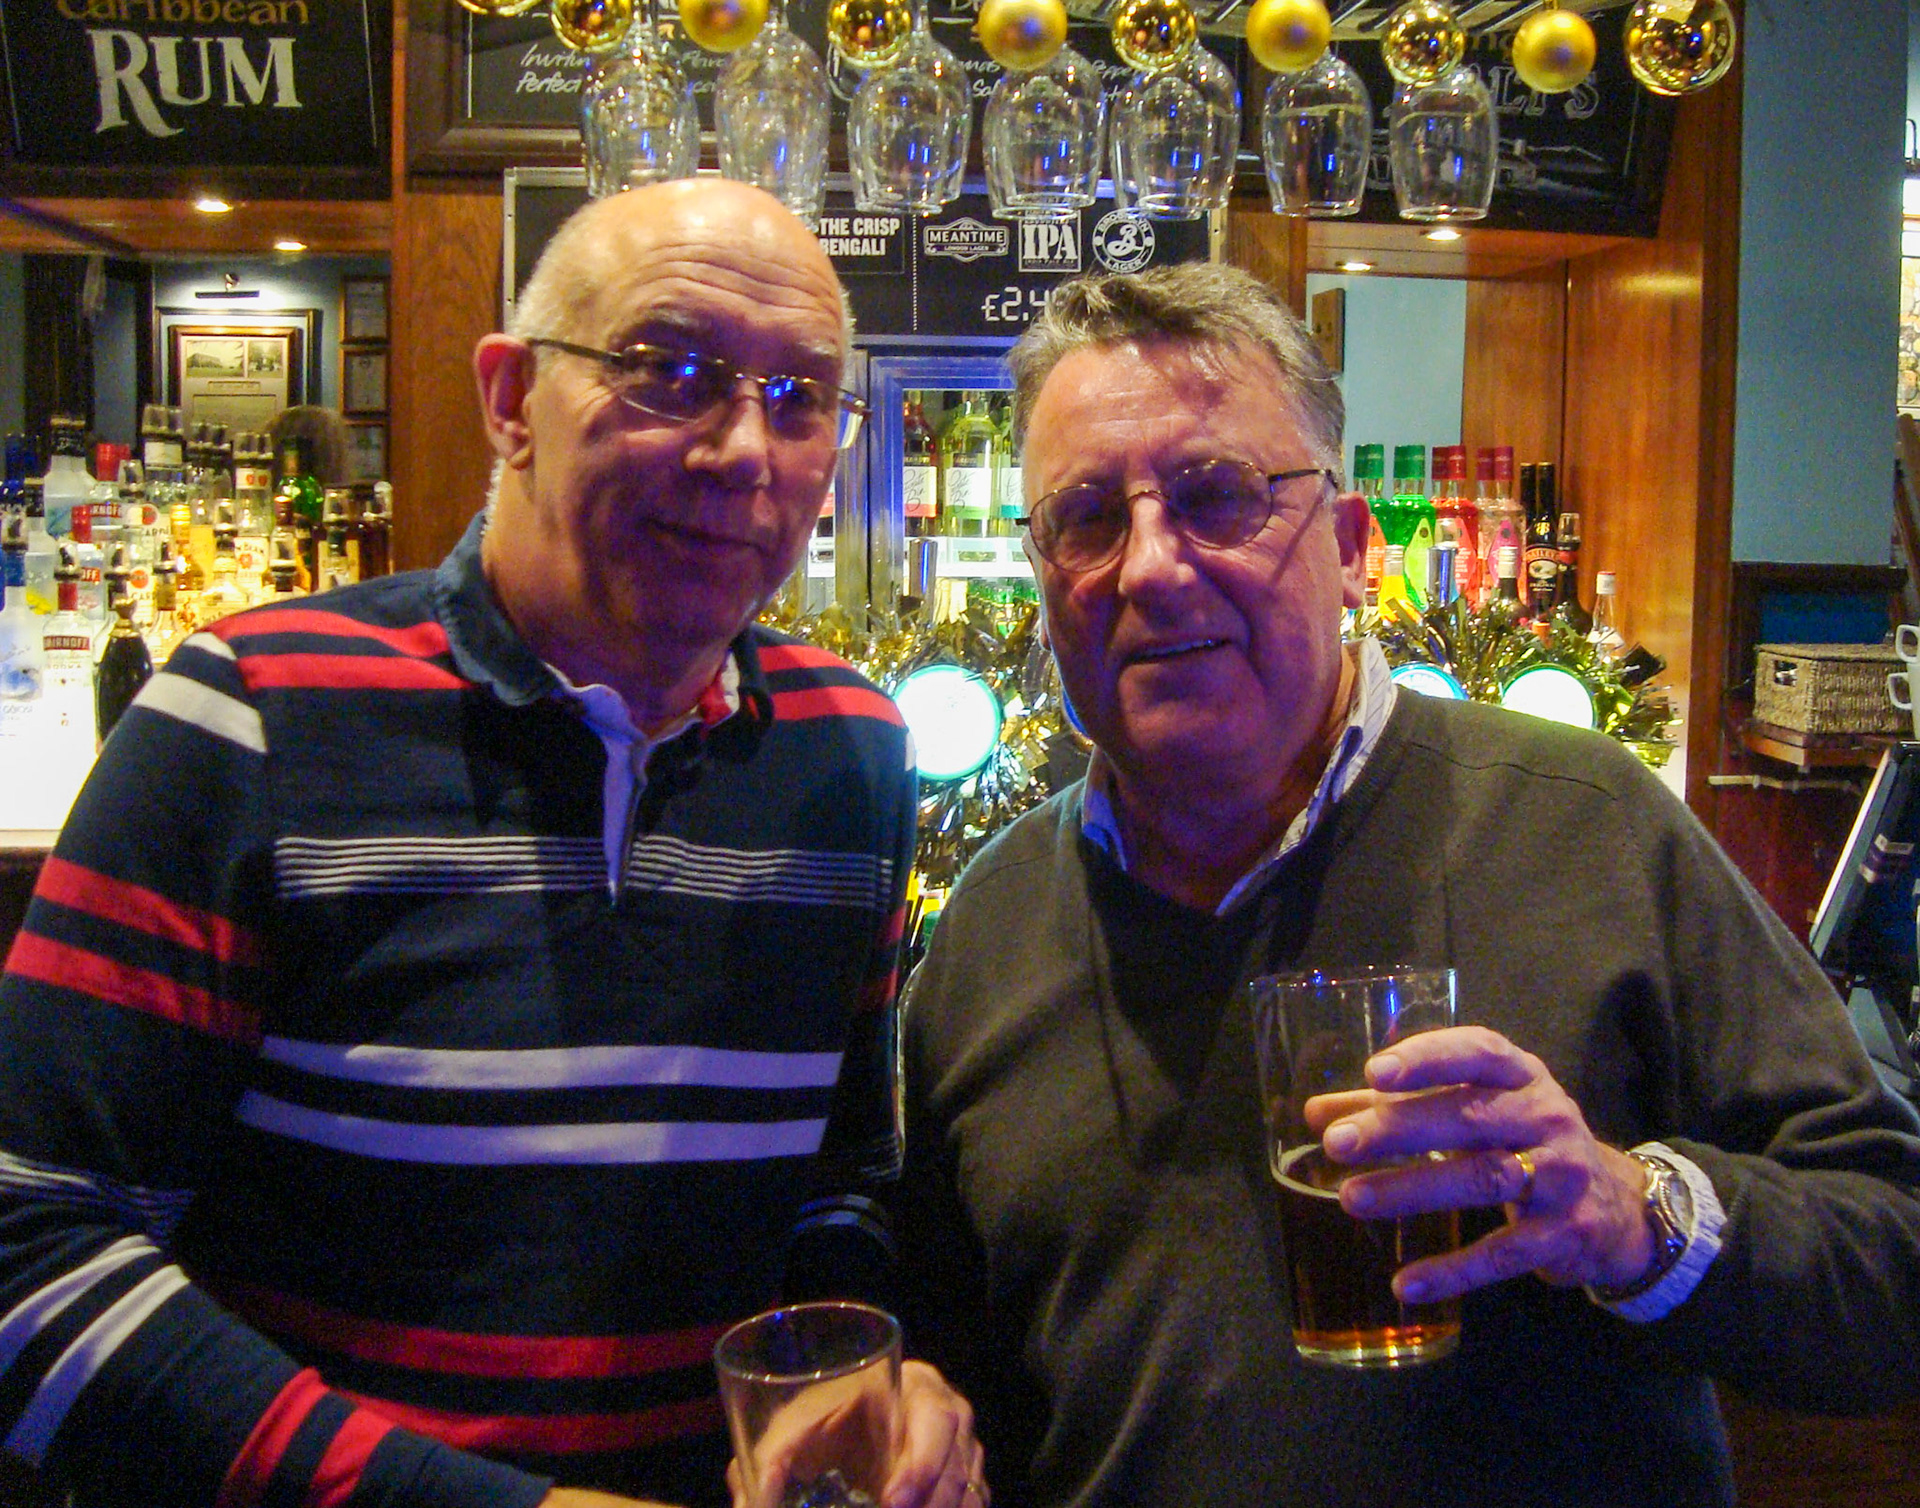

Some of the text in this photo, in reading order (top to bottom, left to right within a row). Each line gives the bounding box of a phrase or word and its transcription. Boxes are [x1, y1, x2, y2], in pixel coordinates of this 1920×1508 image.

[86, 28, 303, 138] RUM
[820, 217, 900, 236] THE CRISP
[929, 230, 1005, 243] MEANTIME
[1022, 223, 1078, 260] IPA
[820, 238, 886, 256] BENGALI
[1105, 257, 1143, 272] LAGER
